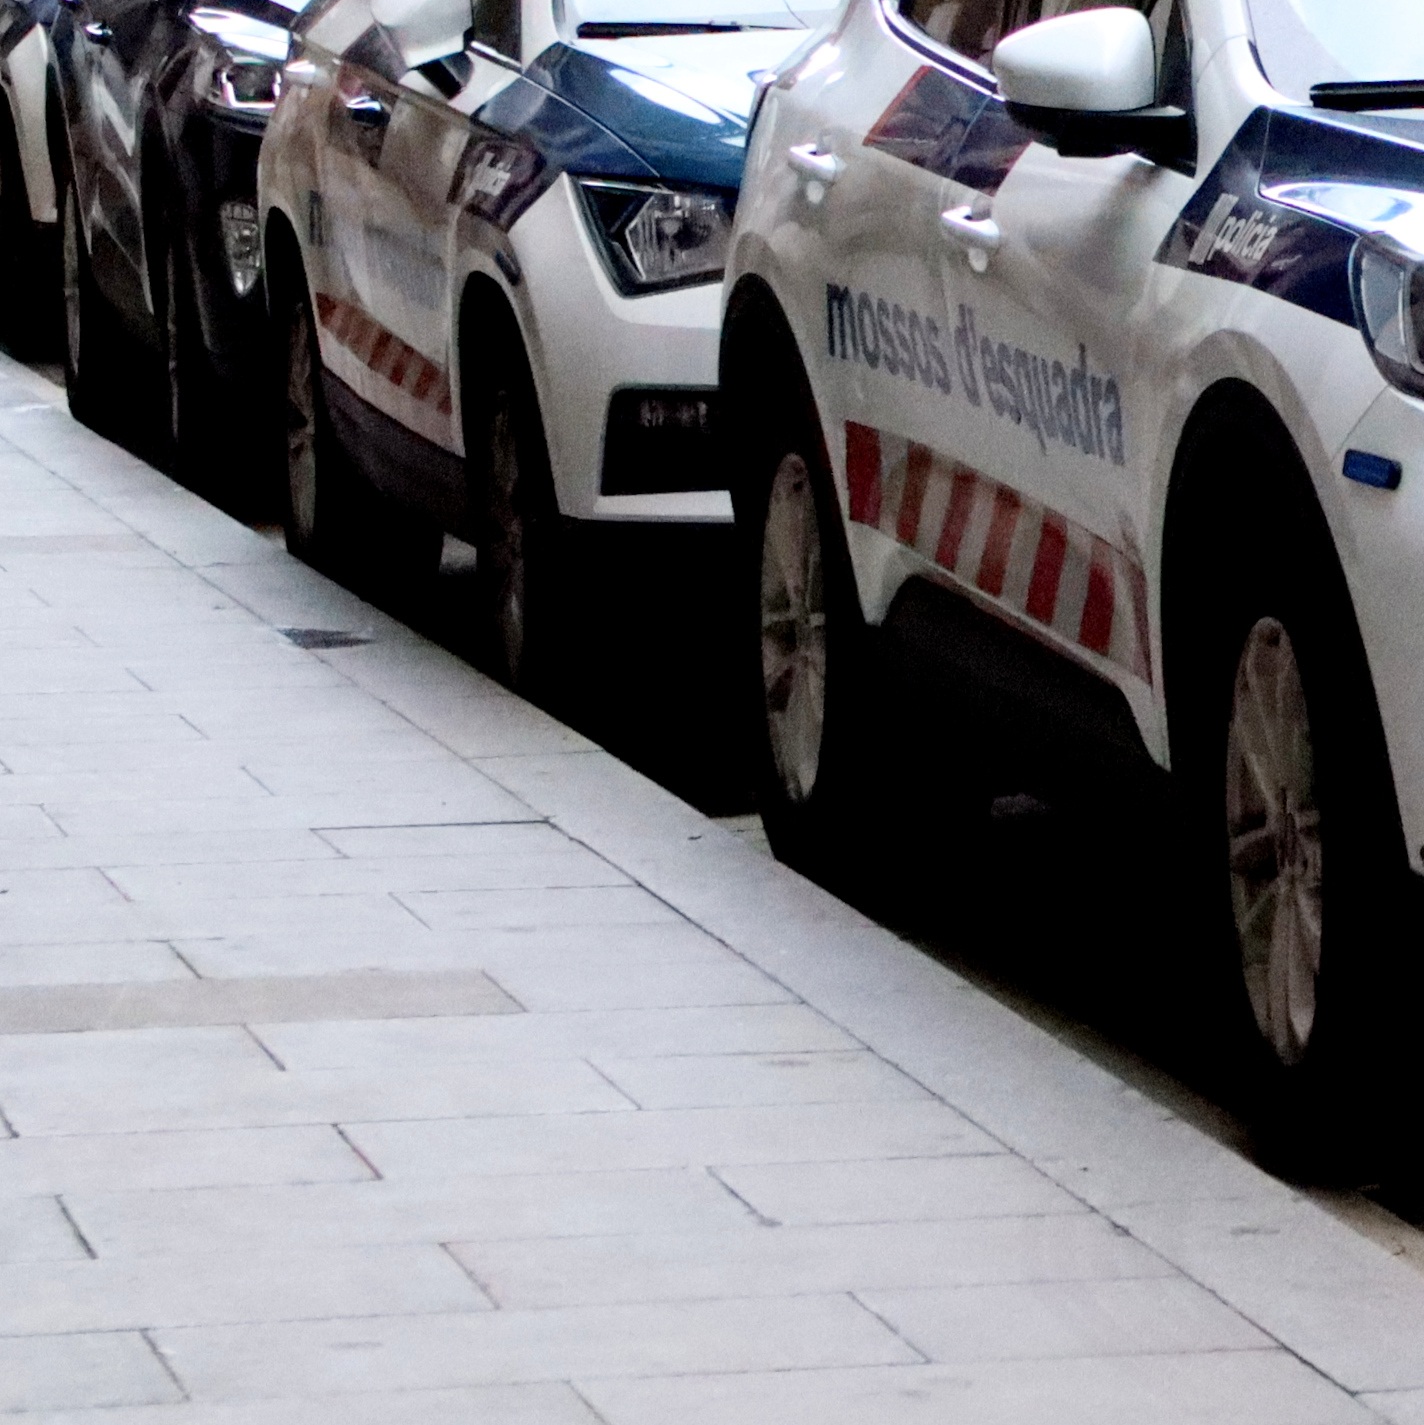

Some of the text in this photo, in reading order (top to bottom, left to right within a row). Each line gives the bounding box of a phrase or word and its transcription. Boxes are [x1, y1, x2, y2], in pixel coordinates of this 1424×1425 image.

[1207, 209, 1279, 262] policia
[827, 283, 1125, 467] mossos d'esquadra
